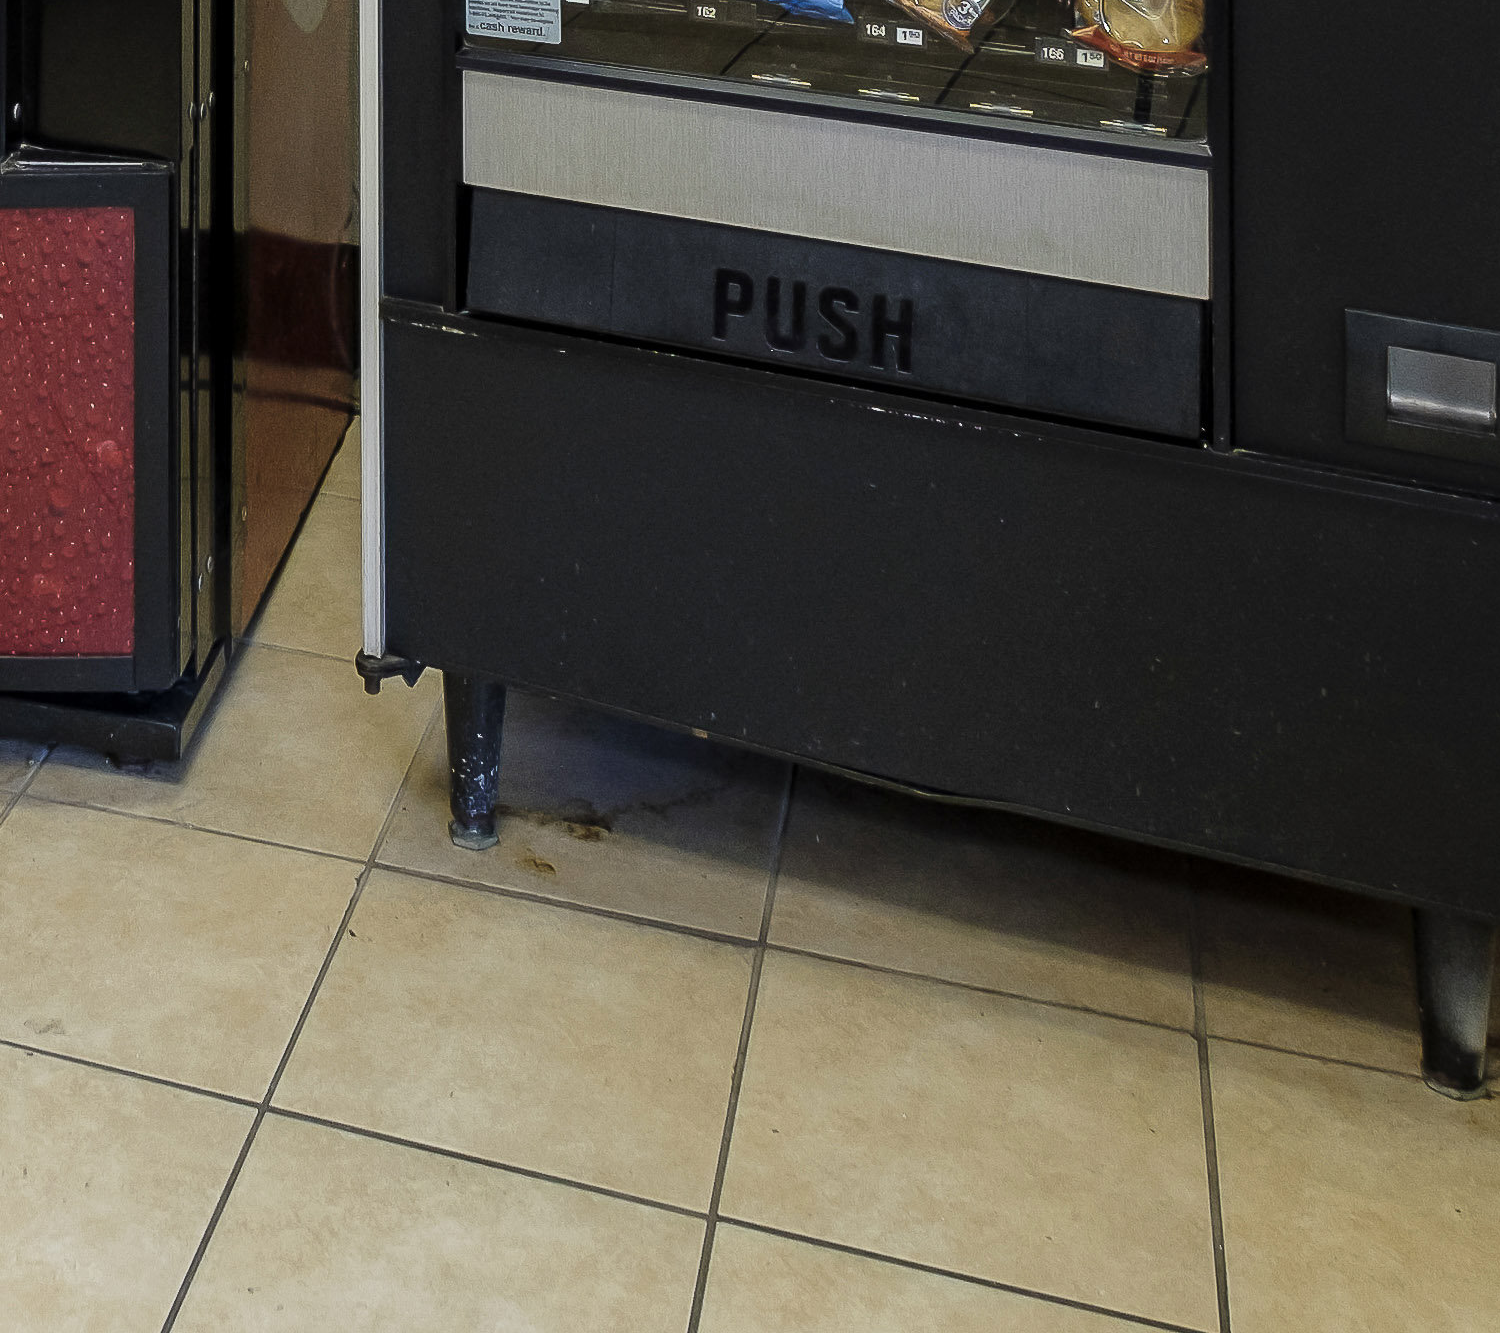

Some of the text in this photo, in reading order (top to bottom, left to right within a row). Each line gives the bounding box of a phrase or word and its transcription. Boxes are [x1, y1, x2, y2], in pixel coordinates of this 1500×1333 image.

[696, 6, 716, 18] 162
[480, 22, 504, 32] cash
[866, 25, 886, 37] 164
[711, 266, 916, 376] PUSH
